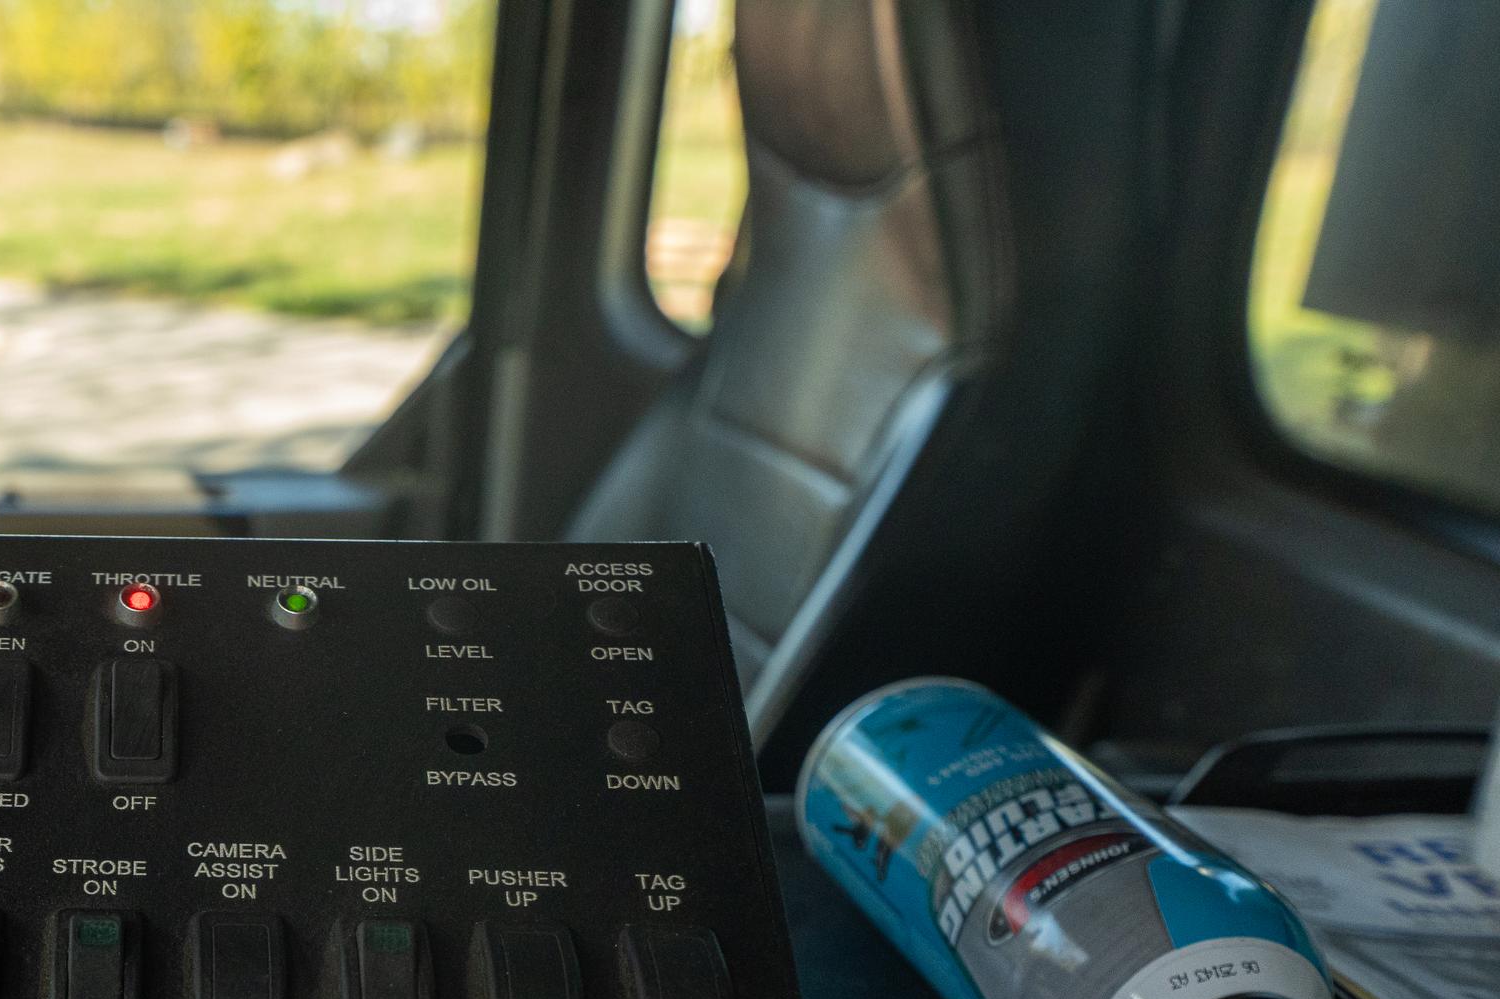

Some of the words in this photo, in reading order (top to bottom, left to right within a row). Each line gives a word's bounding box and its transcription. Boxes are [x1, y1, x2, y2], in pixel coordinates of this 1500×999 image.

[565, 564, 653, 575] ACCESS
[92, 572, 201, 586] THROTTLE
[248, 575, 345, 589] NEUTRAL
[409, 578, 456, 590] LOW
[463, 579, 497, 591] OIL
[578, 580, 642, 592] DOOR
[124, 640, 154, 652] ON
[426, 645, 493, 658] LEVEL
[591, 647, 652, 660] OPEN
[426, 698, 503, 712] FILTER
[606, 700, 653, 714] TAG
[427, 771, 517, 786] BYPASS
[606, 775, 679, 790] DOWN
[113, 796, 156, 810] OFF
[188, 843, 286, 859] CAMERA
[350, 847, 403, 862] SIDE
[53, 859, 147, 875] STROBE
[194, 863, 278, 879] ASSIST
[336, 866, 419, 882] LIGHTS
[469, 870, 567, 887] PUSHER
[635, 874, 685, 890] TAG
[84, 880, 117, 895] ON
[222, 884, 256, 899] ON
[362, 888, 396, 902] ON
[506, 891, 537, 906] UP
[648, 896, 680, 911] UP
